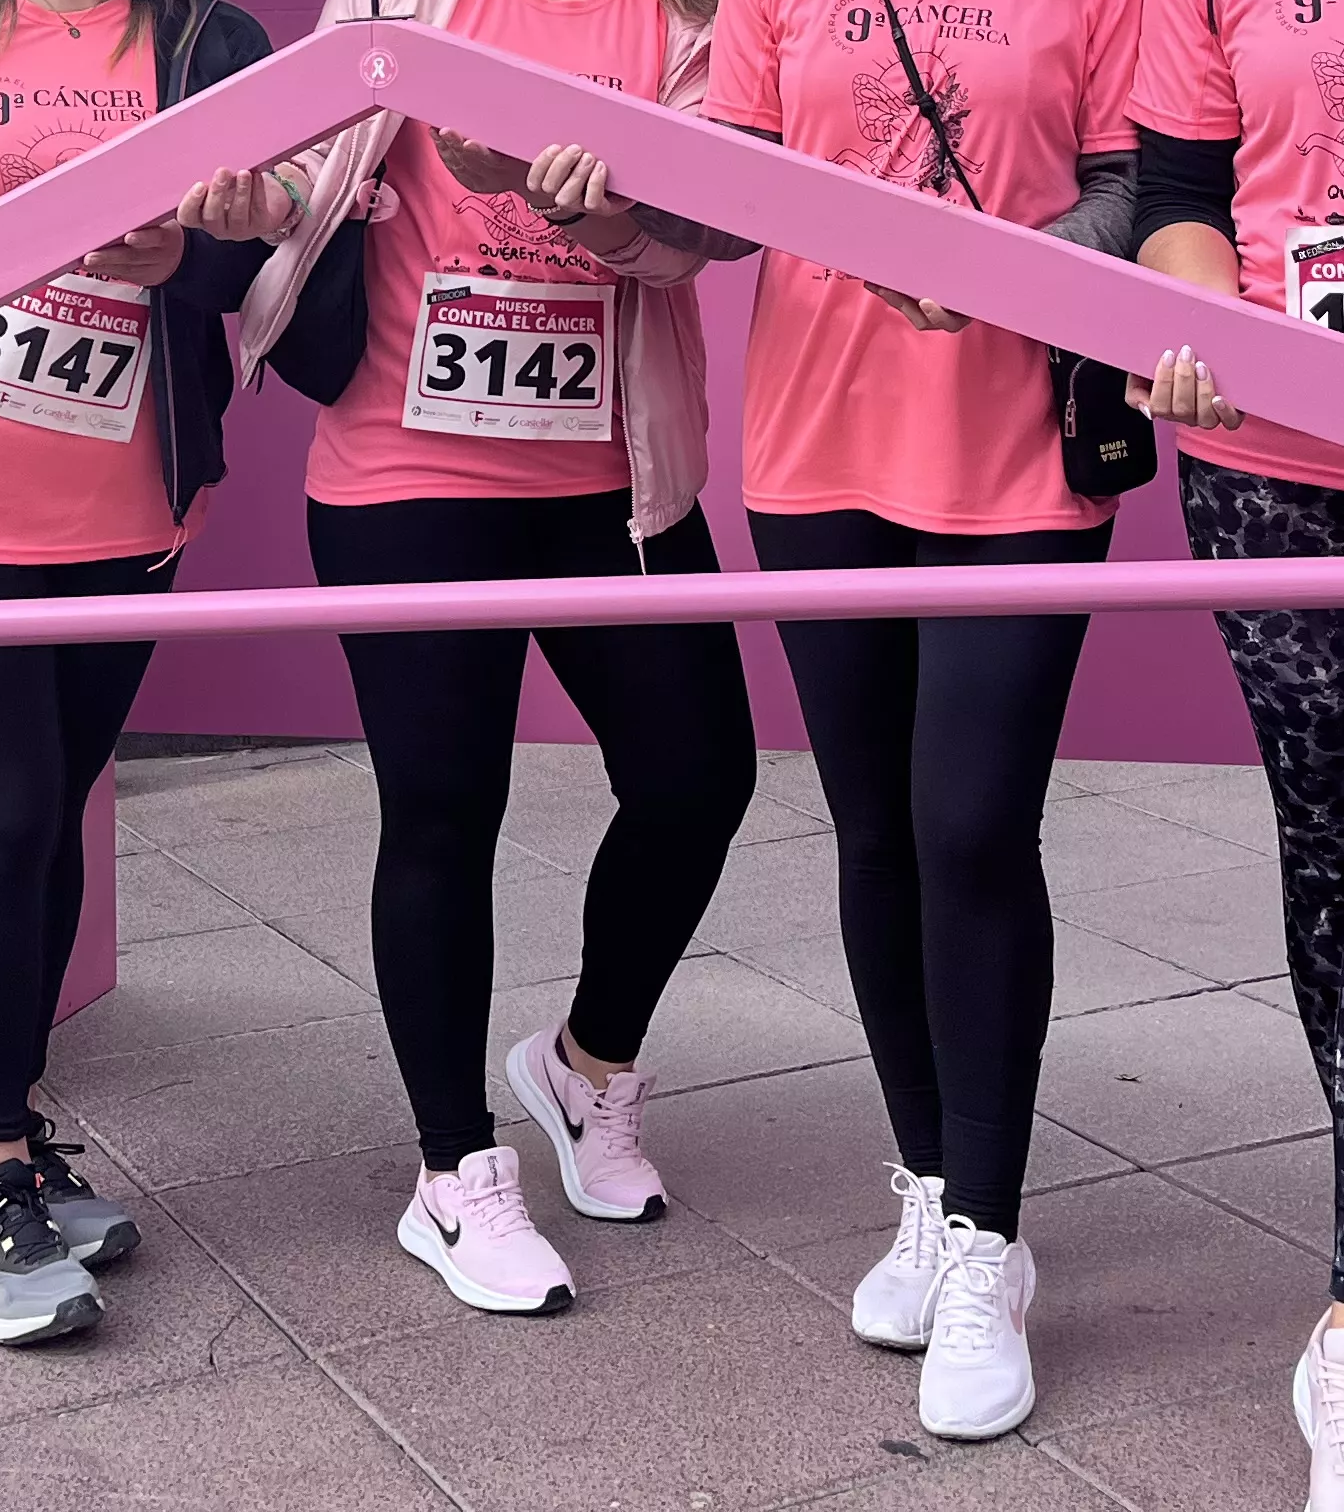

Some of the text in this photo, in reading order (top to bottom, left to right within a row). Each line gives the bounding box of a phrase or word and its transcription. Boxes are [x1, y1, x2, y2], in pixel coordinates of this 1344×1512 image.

[845, 0, 993, 42] 9ª CÁNCER
[938, 24, 1011, 46] HUESCA
[33, 86, 145, 108] CÁNCER
[92, 109, 155, 122] HUESC
[545, 254, 590, 272] MUCHO
[45, 288, 93, 309] HUESCA
[495, 299, 546, 314] HUESCA
[12, 294, 139, 335] TRA EL CÁNCER
[437, 307, 596, 332] CONTRA EL CÁNCER
[425, 333, 597, 401] 3142
